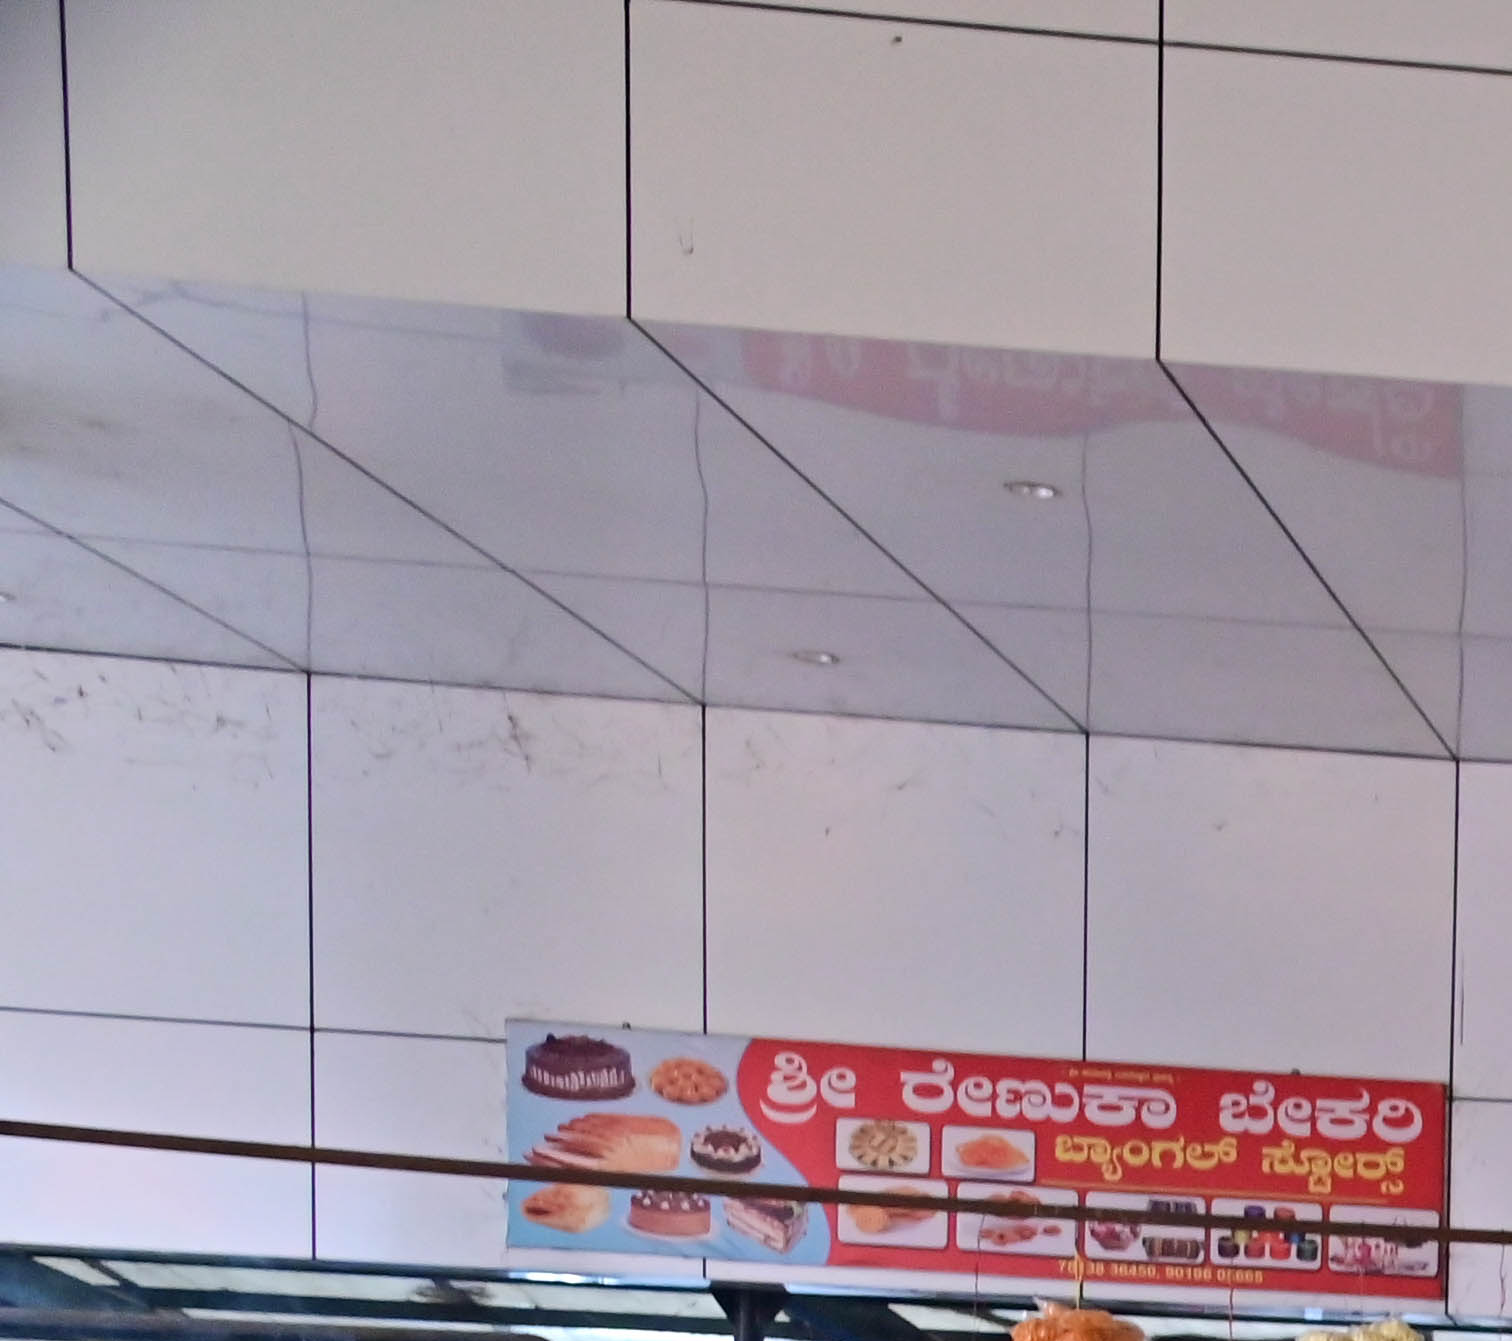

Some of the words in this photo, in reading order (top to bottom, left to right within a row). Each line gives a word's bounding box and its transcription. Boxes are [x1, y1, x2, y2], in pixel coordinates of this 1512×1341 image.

[760, 1051, 857, 1124] ಶ್ರೀ
[900, 1058, 1177, 1129] ರೇಣುಕಾ
[1218, 1079, 1423, 1143] ಬೇಕರಿ
[1054, 1134, 1238, 1182] ಬ್ಯಾಂಗಲ್
